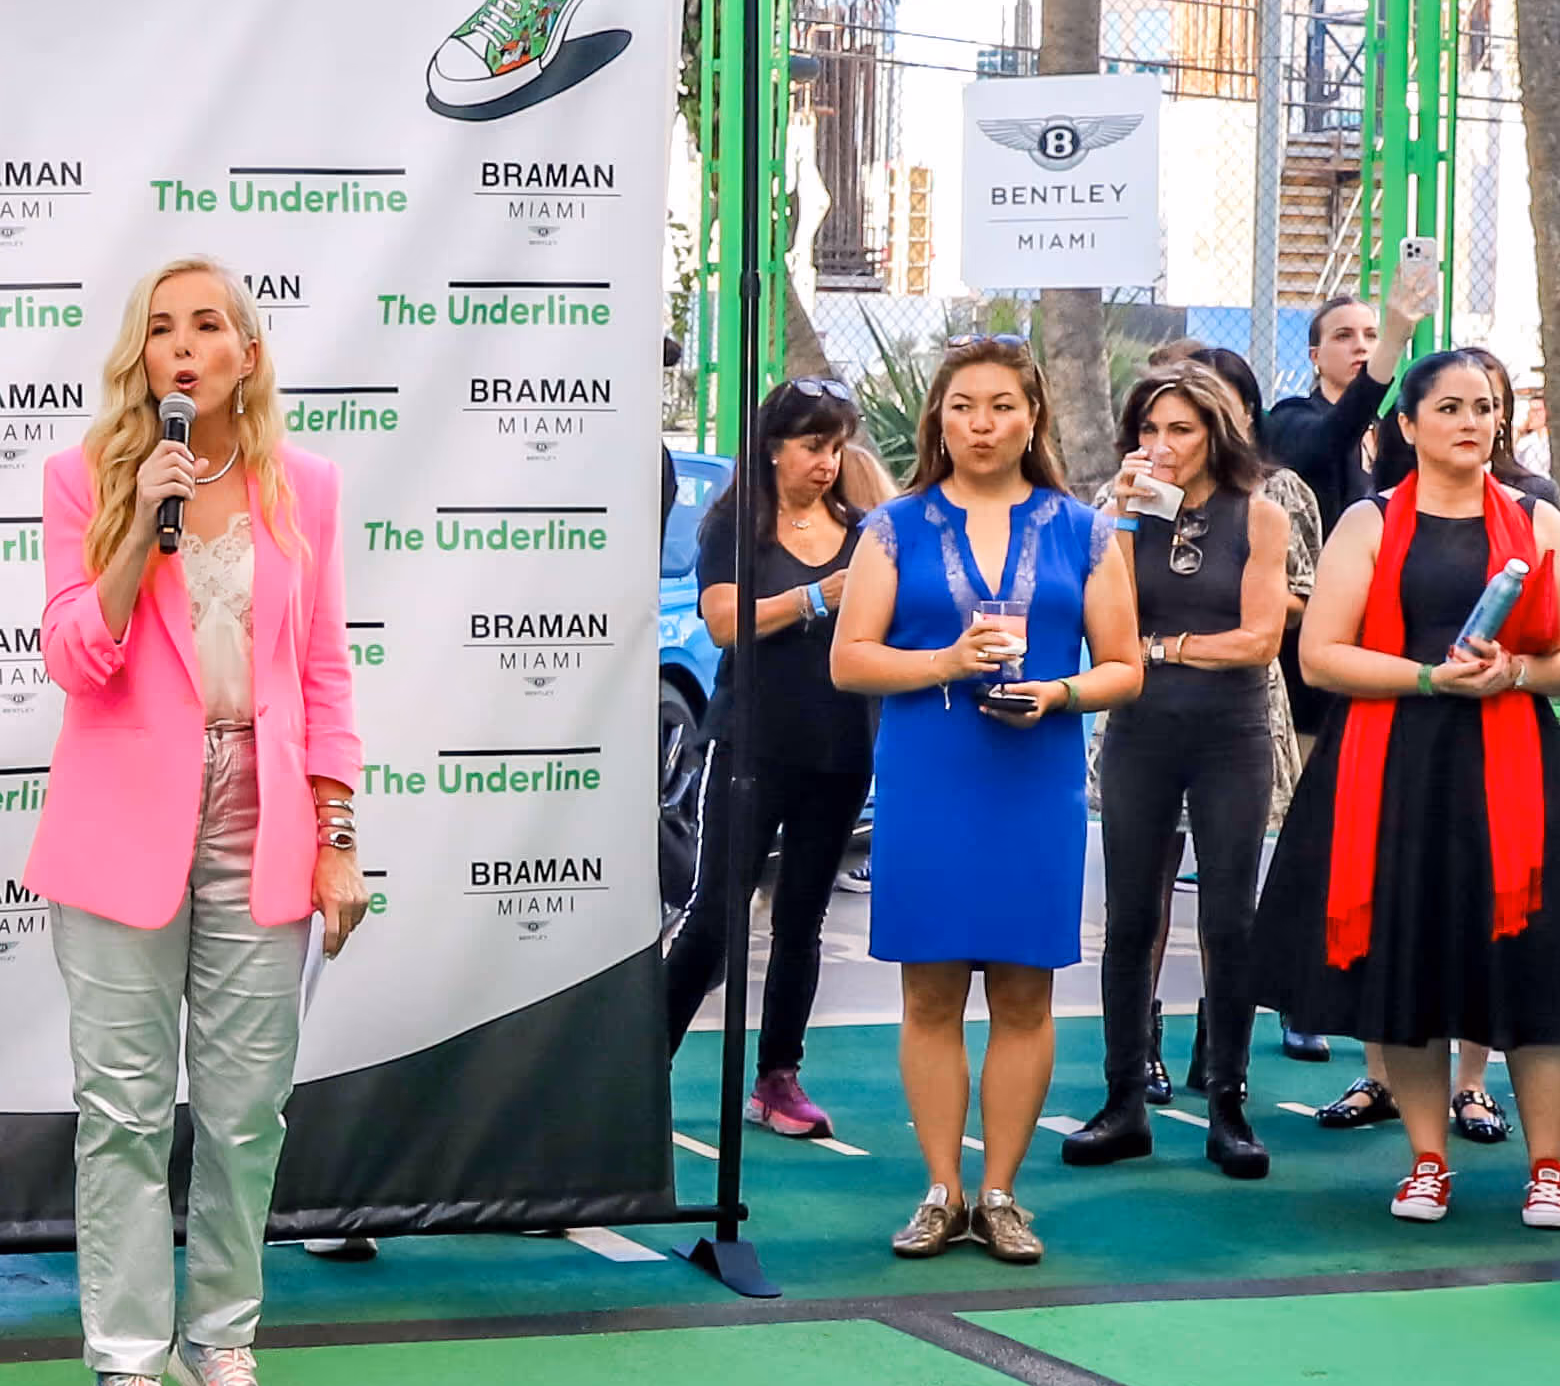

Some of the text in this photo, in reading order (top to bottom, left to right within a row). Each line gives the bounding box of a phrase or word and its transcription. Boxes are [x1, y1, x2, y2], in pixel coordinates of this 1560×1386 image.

[482, 162, 613, 188] BRAMAN
[152, 181, 407, 212] The Underline
[991, 183, 1128, 206] BENTLEY
[509, 202, 584, 218] MIAMI
[1018, 232, 1097, 251] MIAMI
[378, 295, 610, 325] The Underline
[471, 379, 610, 403] BRAMAN
[288, 400, 397, 432] derline
[499, 417, 583, 433] MIAMI
[365, 520, 606, 551] The Underline
[471, 613, 607, 638] BRAMAN
[501, 653, 580, 669] MIAMI
[366, 763, 600, 794] The Underline
[472, 858, 601, 885] BRAMAN
[498, 896, 573, 915] MIAMI
